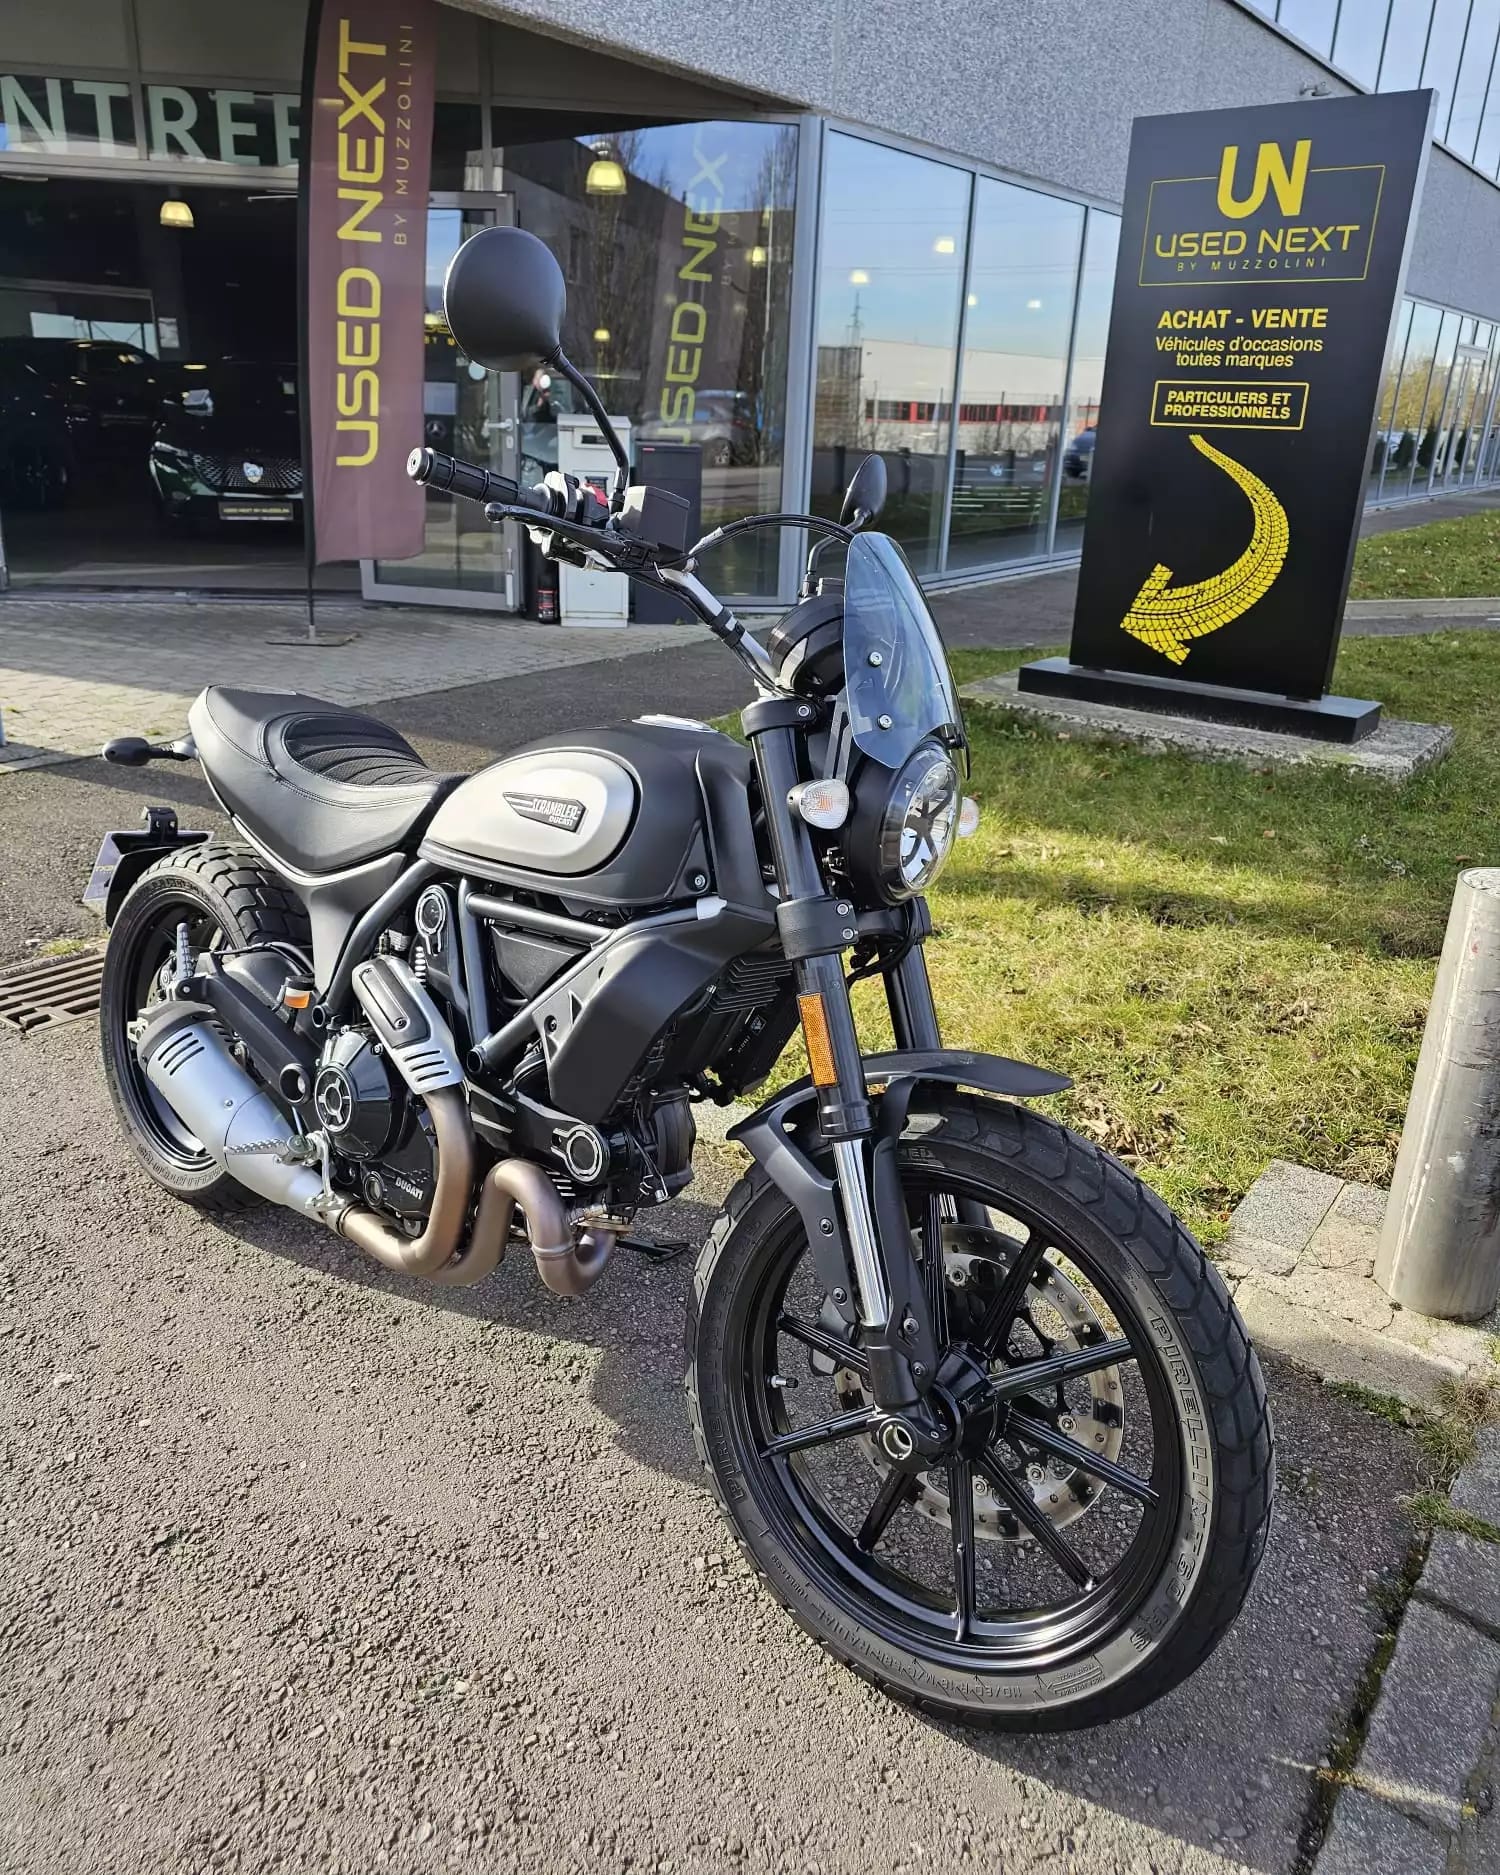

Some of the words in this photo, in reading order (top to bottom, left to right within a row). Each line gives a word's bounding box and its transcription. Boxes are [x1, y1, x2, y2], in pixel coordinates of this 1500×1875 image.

[395, 25, 414, 195] MUZZOLINI
[337, 19, 387, 243] NEXT
[1217, 139, 1312, 219] UN
[394, 214, 408, 245] BY
[1156, 230, 1248, 258] USED
[1257, 225, 1361, 254] NEXT
[1177, 261, 1198, 272] BY
[1211, 256, 1326, 271] MUZZOLINI
[1157, 309, 1232, 329] ACHAT
[1251, 308, 1329, 328] VENTE
[1156, 336, 1225, 352] Véhicules
[1229, 336, 1324, 352] d'occasions
[337, 267, 382, 467] USED
[1176, 352, 1222, 367] toutes
[1225, 354, 1295, 370] marques
[1167, 391, 1268, 405] PARTICULIERS
[1271, 392, 1292, 405] ET
[1164, 404, 1291, 419] PROFESSIONNELS
[532, 798, 579, 821] SCRAMBLER
[395, 1176, 424, 1201] DUCATI
[1150, 1316, 1210, 1493] PIRELLI
